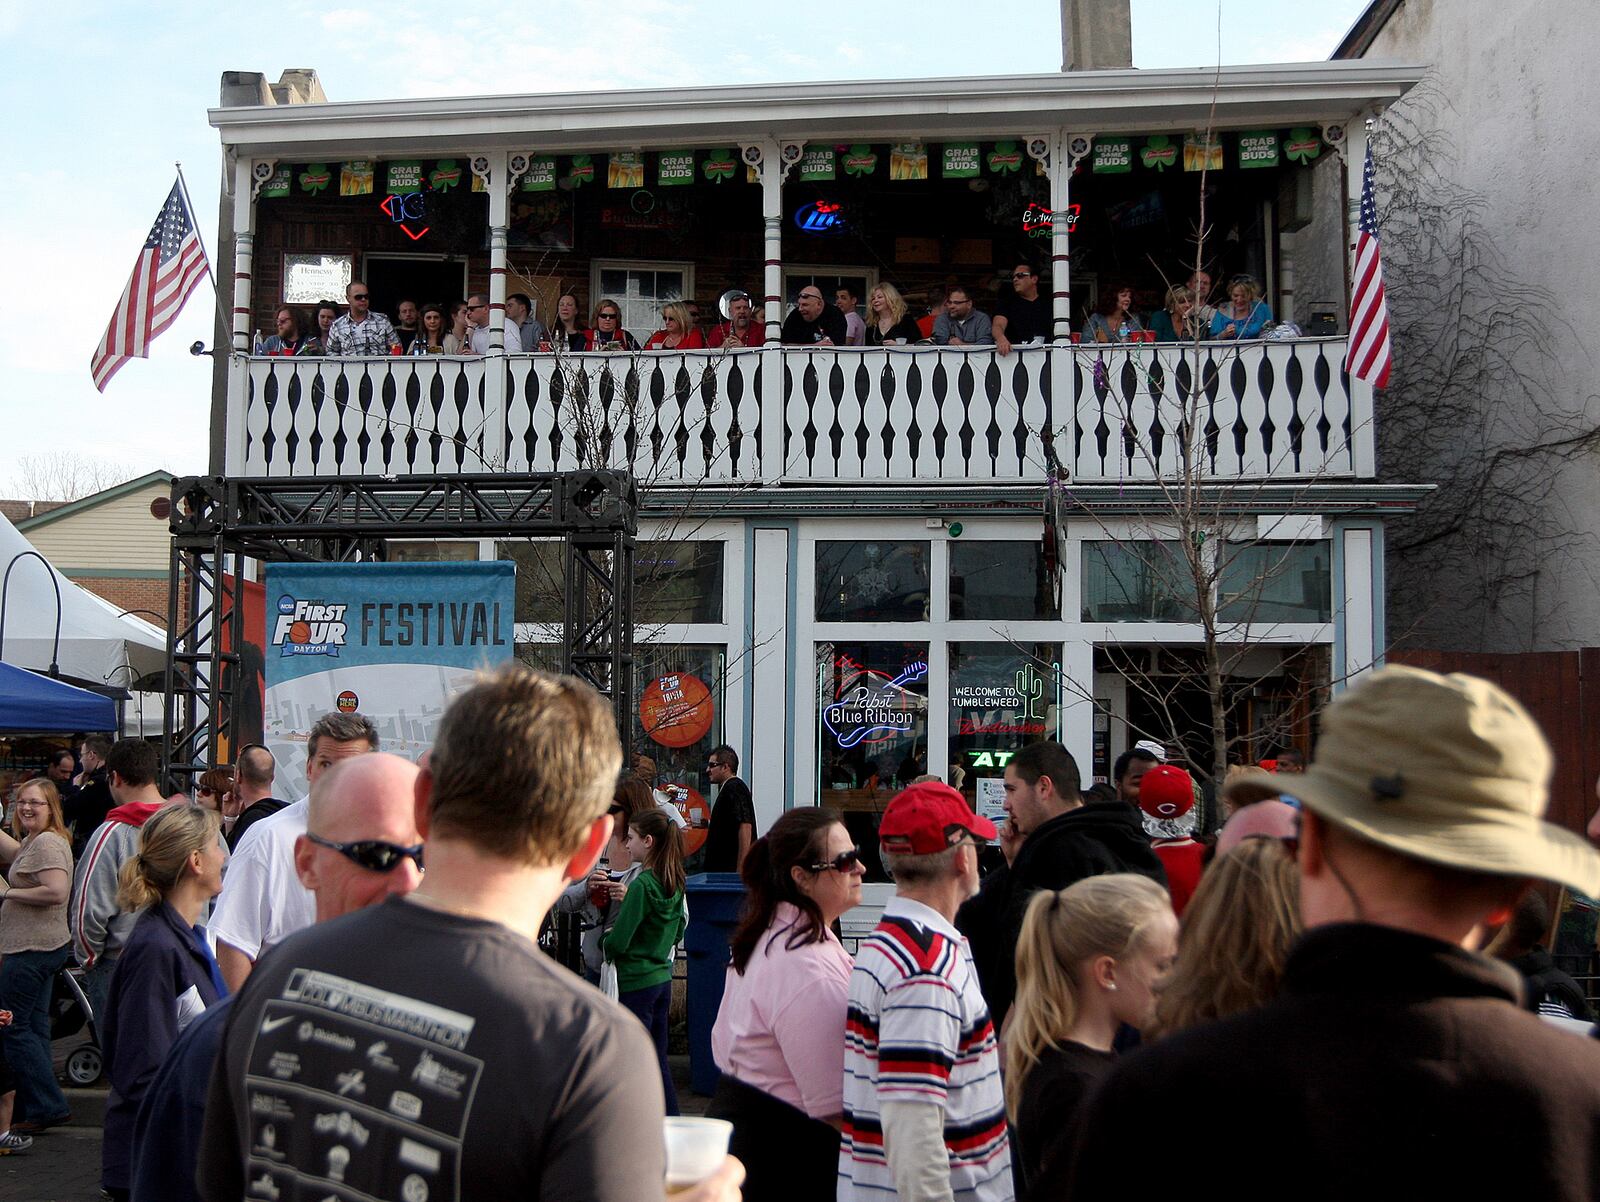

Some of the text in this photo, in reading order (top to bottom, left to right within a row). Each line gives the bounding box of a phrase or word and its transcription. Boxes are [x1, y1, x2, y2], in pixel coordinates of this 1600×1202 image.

[1240, 137, 1275, 147] GRAB
[945, 148, 978, 157] GRAB
[1094, 144, 1129, 153] GRAB
[1241, 150, 1276, 161] BUDS
[531, 161, 555, 171] RAB
[661, 156, 693, 166] GRAB
[945, 161, 978, 170] BUDS
[1095, 157, 1129, 166] BUDS
[390, 166, 421, 175] GRAB
[661, 169, 693, 178] BUDS
[801, 164, 833, 173] BUDS
[389, 178, 420, 187] BUDS
[523, 174, 554, 184] BUDS
[1028, 228, 1053, 239] OPE
[301, 266, 335, 276] Hennessy
[294, 600, 347, 621] FIRST
[361, 602, 506, 646] FESTIVAL
[293, 645, 328, 653] DAYTON
[663, 690, 685, 703] TRIVIA
[853, 686, 896, 708] Pabst
[955, 687, 1016, 697] WELCOME TO
[952, 697, 1020, 707] TUMBLEWEED
[831, 708, 913, 723] Blue Ribbon
[1157, 803, 1176, 814] C
[384, 1007, 468, 1050] MARATHON
